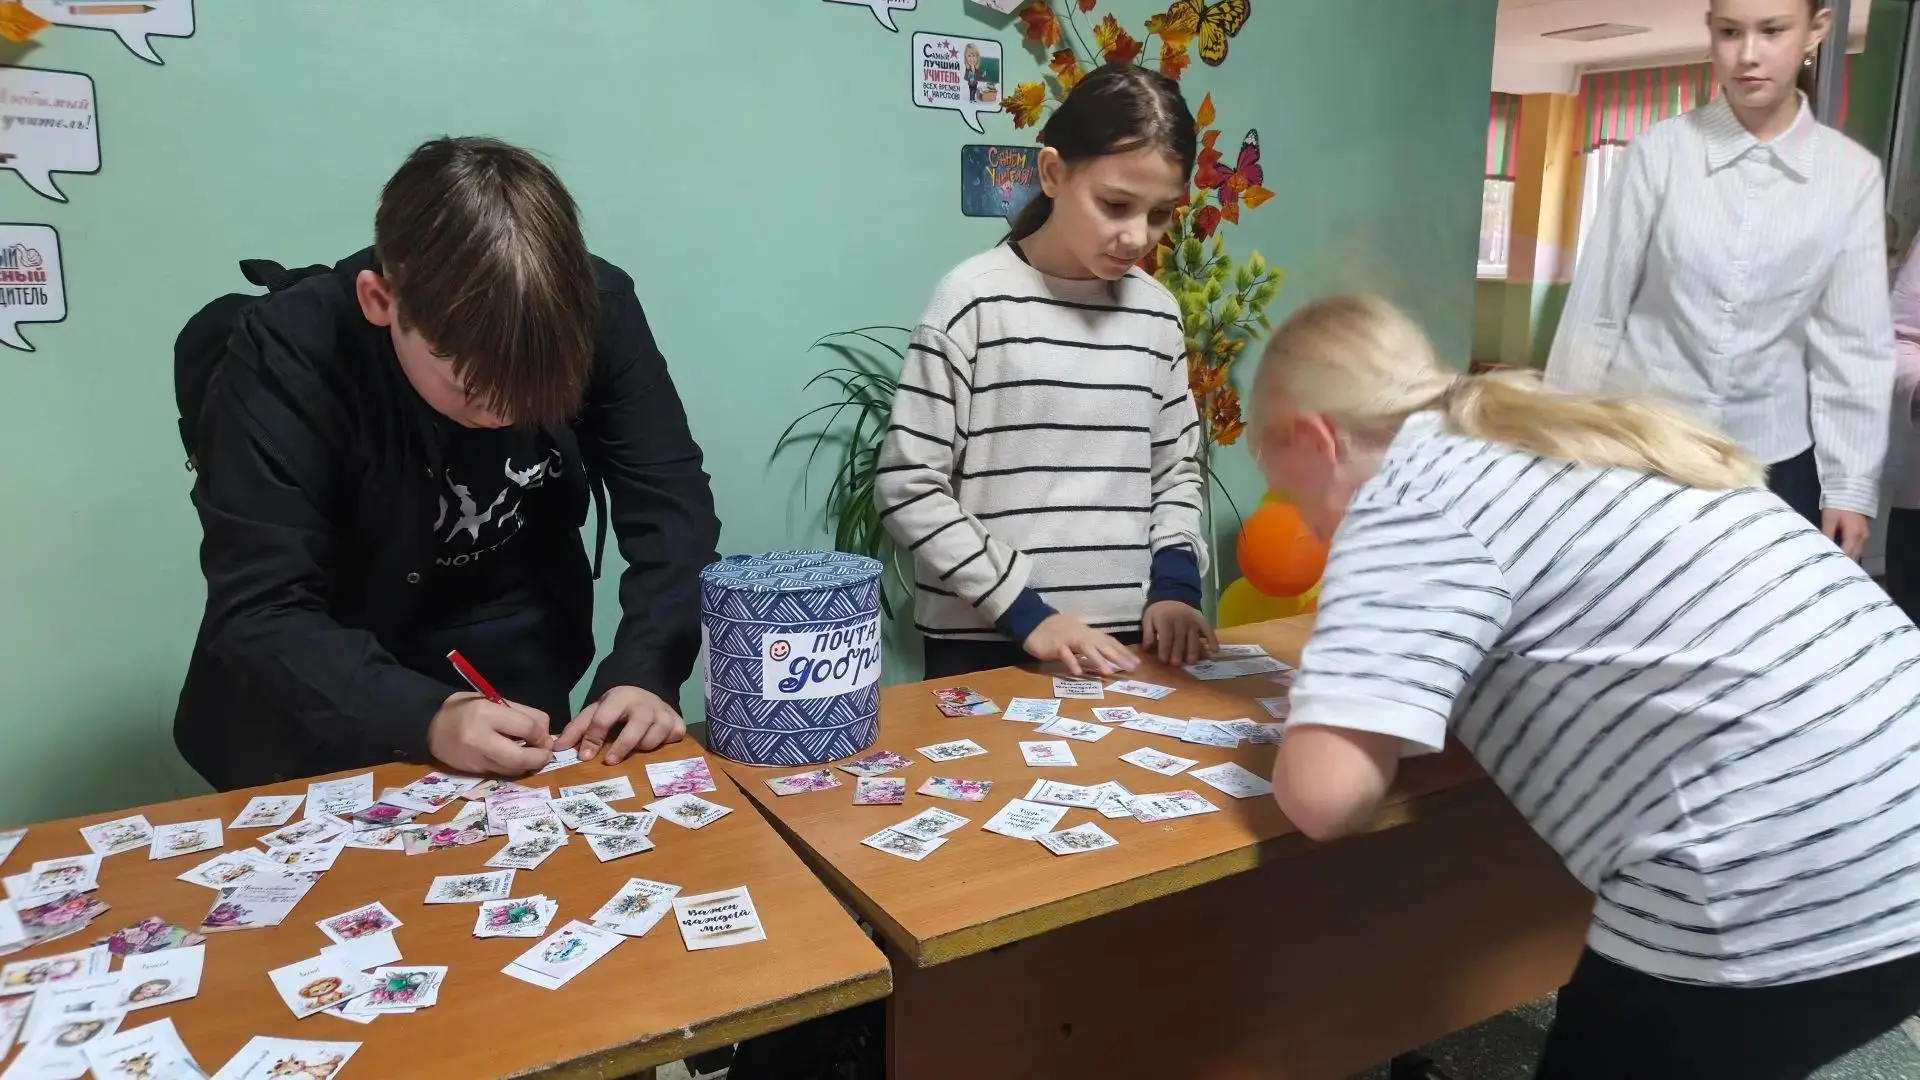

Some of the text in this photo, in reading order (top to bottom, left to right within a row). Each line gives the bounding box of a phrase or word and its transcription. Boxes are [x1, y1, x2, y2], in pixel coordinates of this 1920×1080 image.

[923, 60, 960, 71] ЛУЧШИЙ
[923, 69, 960, 84] УЧИТЕЛЬ
[436, 549, 484, 566] NOT
[811, 623, 876, 654] ПОЧТА
[778, 642, 880, 694] добра
[687, 904, 739, 917] Важен
